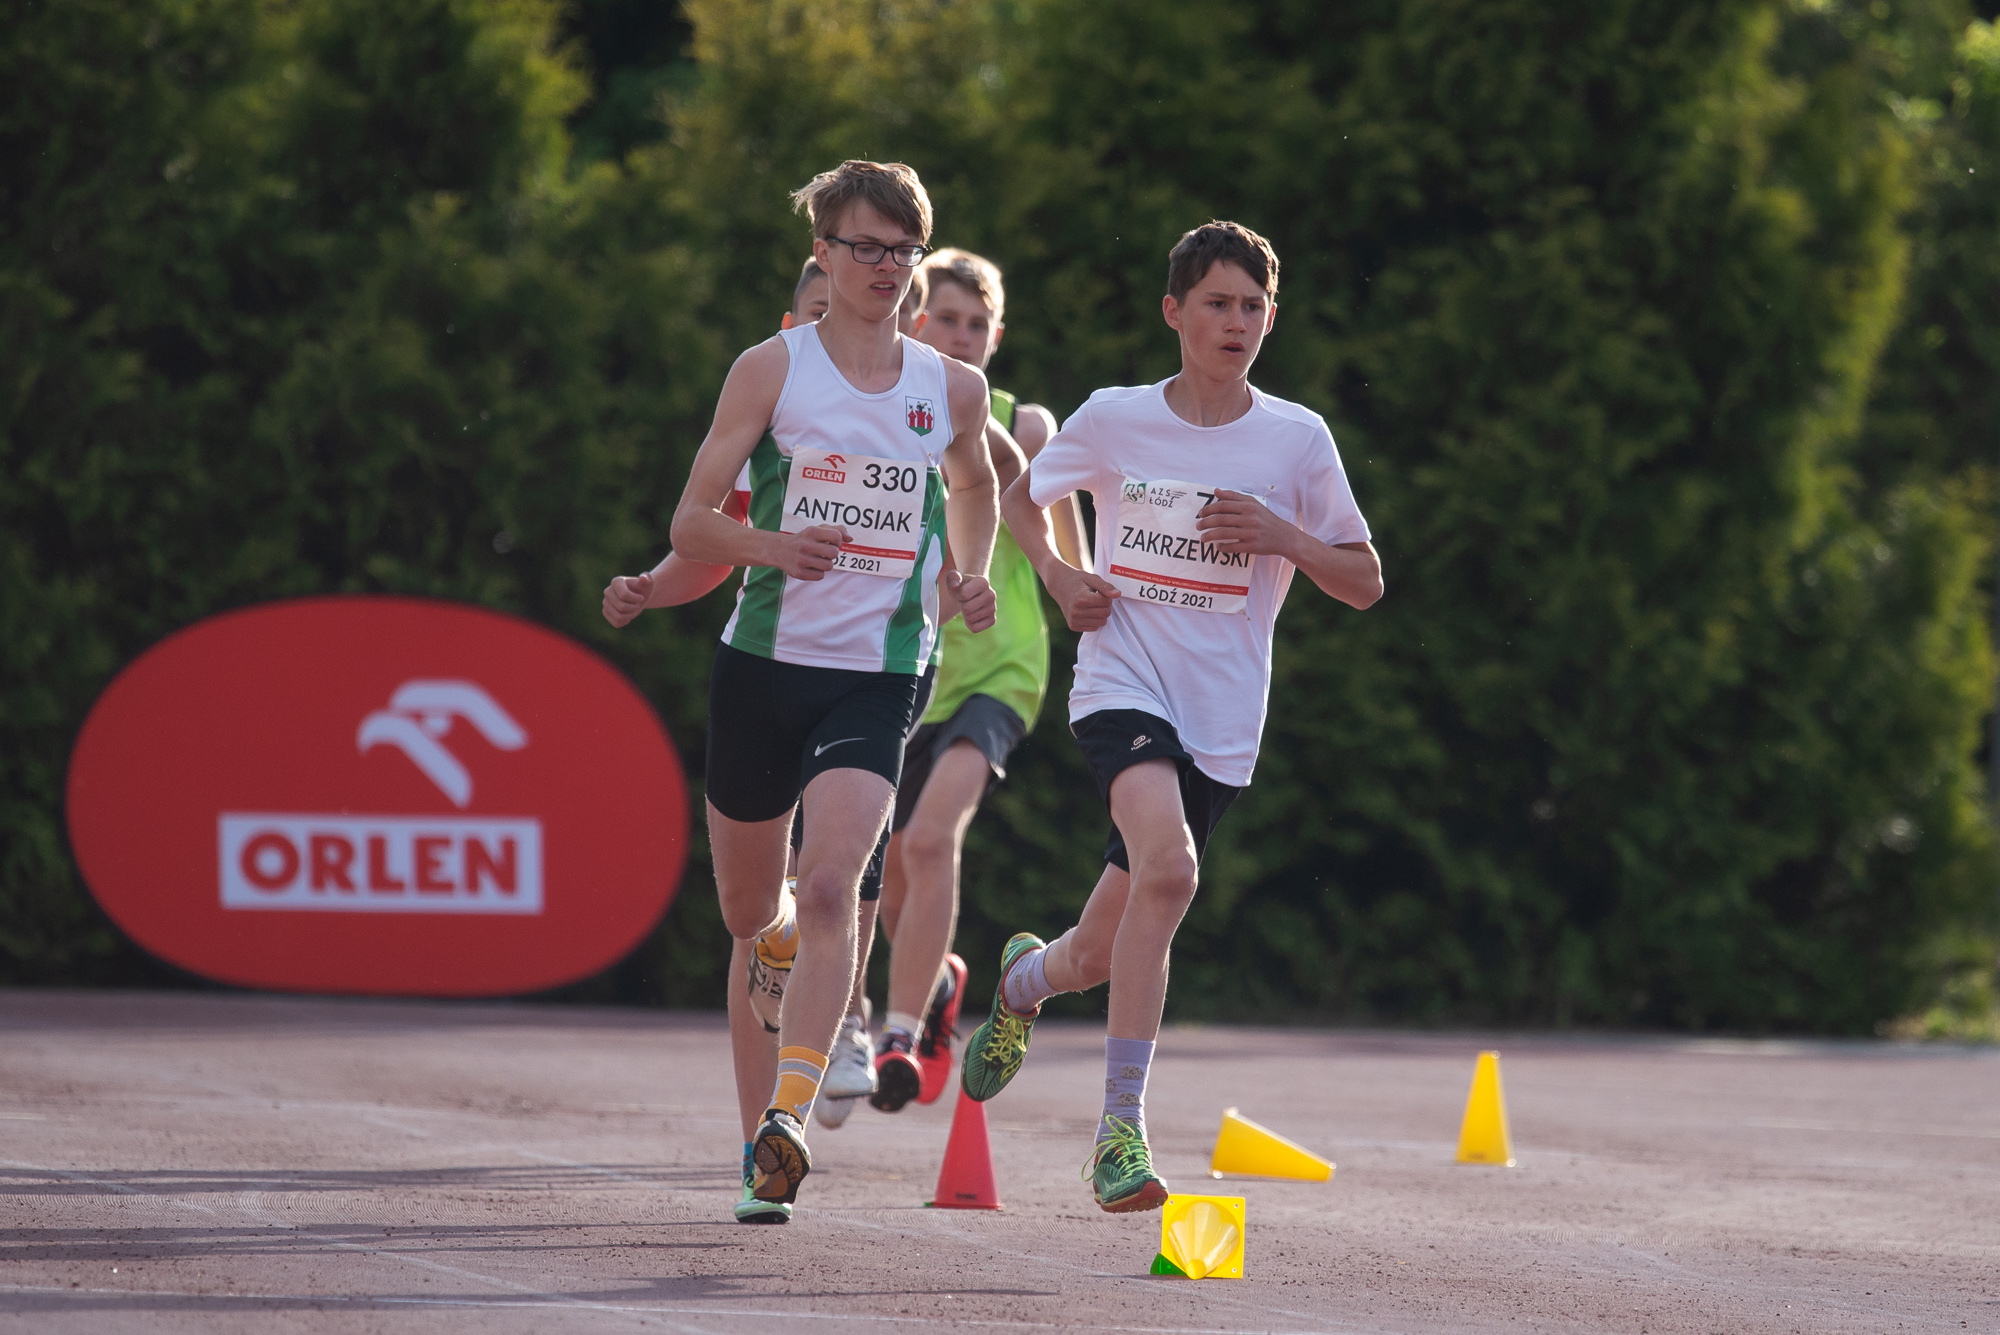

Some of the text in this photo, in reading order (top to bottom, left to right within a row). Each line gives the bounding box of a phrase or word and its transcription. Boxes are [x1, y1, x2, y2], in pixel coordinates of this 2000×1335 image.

[805, 469, 844, 482] ORLEN
[863, 464, 917, 493] 330
[793, 496, 913, 533] ANTOSIAK
[1119, 525, 1250, 568] ZAKRZEWSKI
[850, 557, 881, 573] 2021
[1138, 584, 1213, 609] ŁÓDŹ 2021
[240, 832, 516, 894] ORLEN
